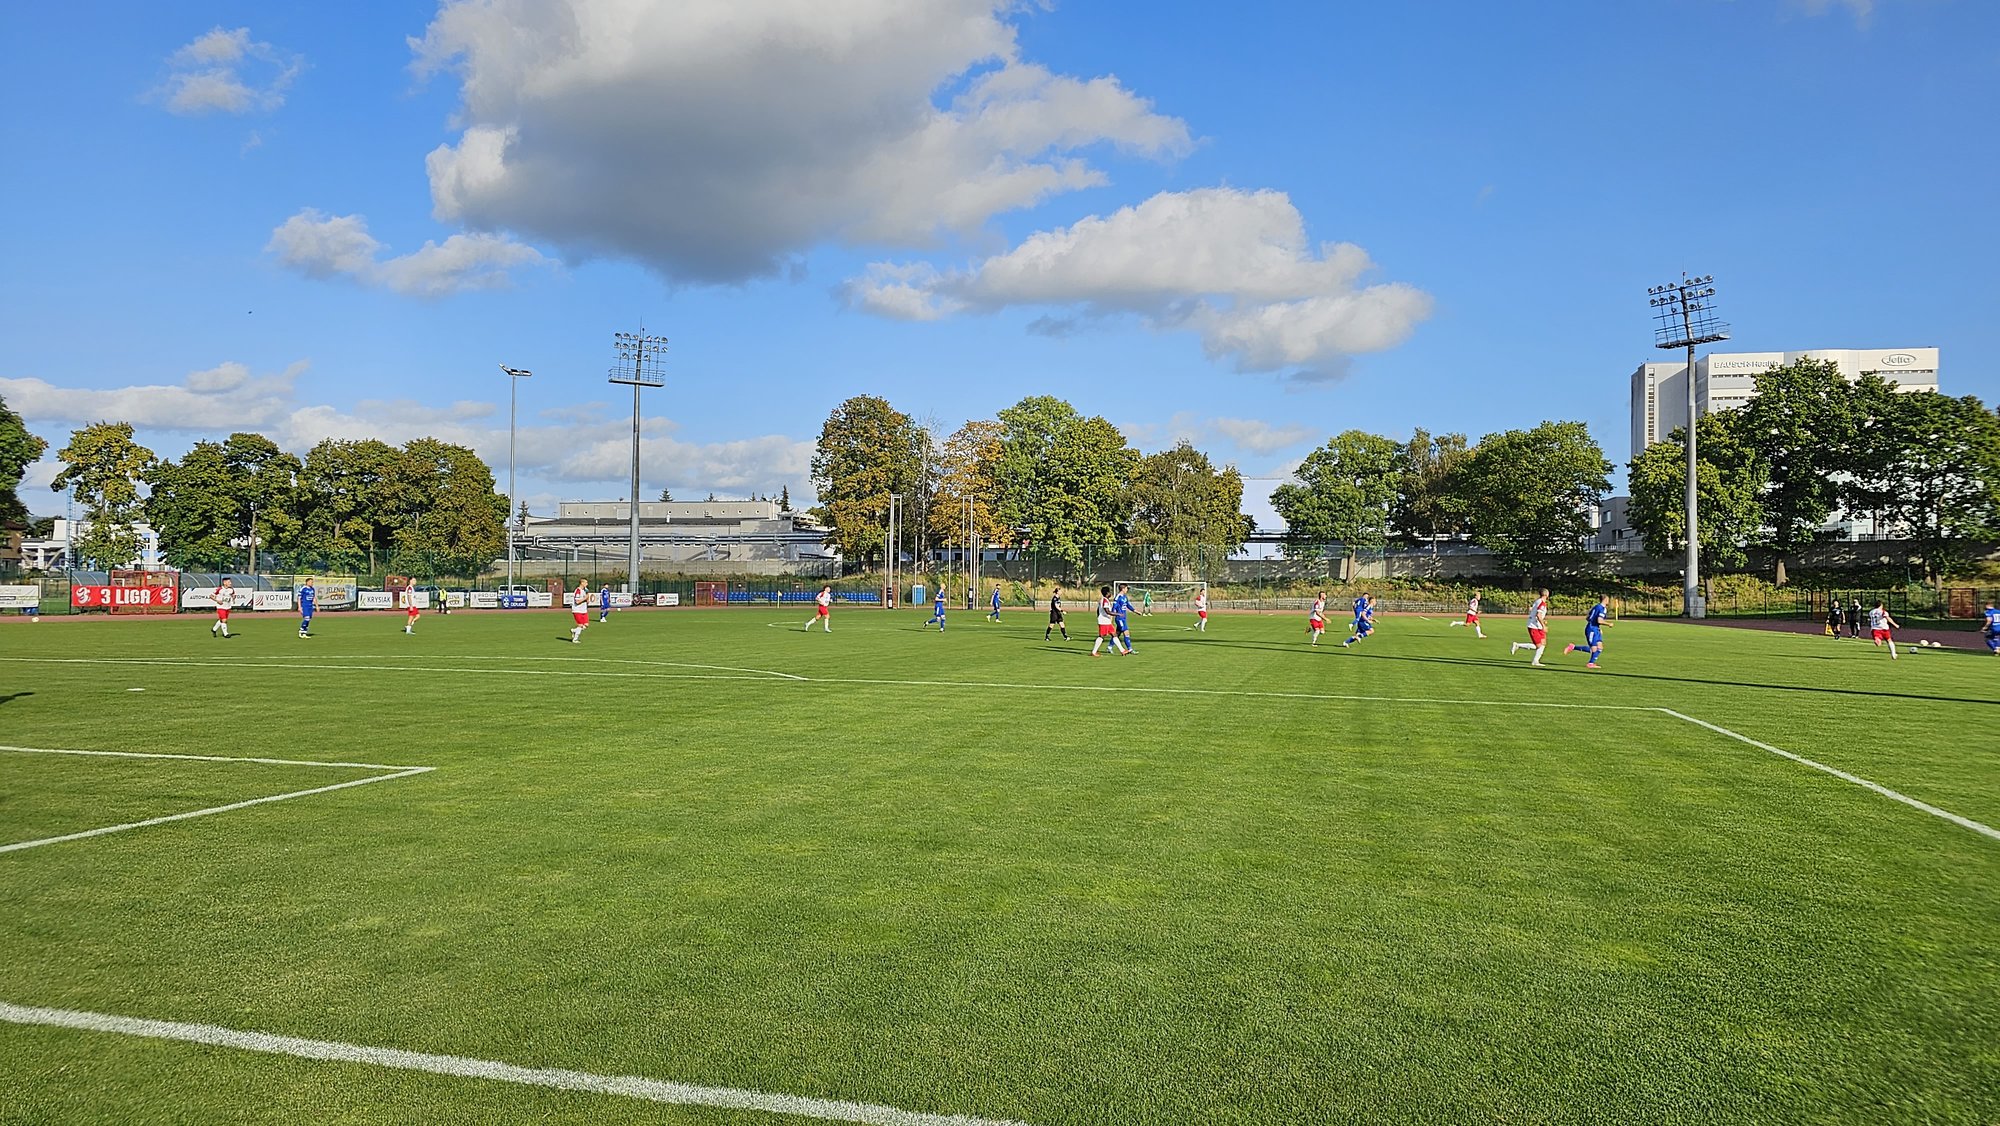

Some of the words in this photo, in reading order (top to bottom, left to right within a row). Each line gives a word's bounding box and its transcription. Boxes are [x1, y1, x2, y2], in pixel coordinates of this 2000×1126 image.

[101, 588, 111, 605] 3
[115, 588, 151, 605] LIGA
[265, 594, 290, 602] VOTUM
